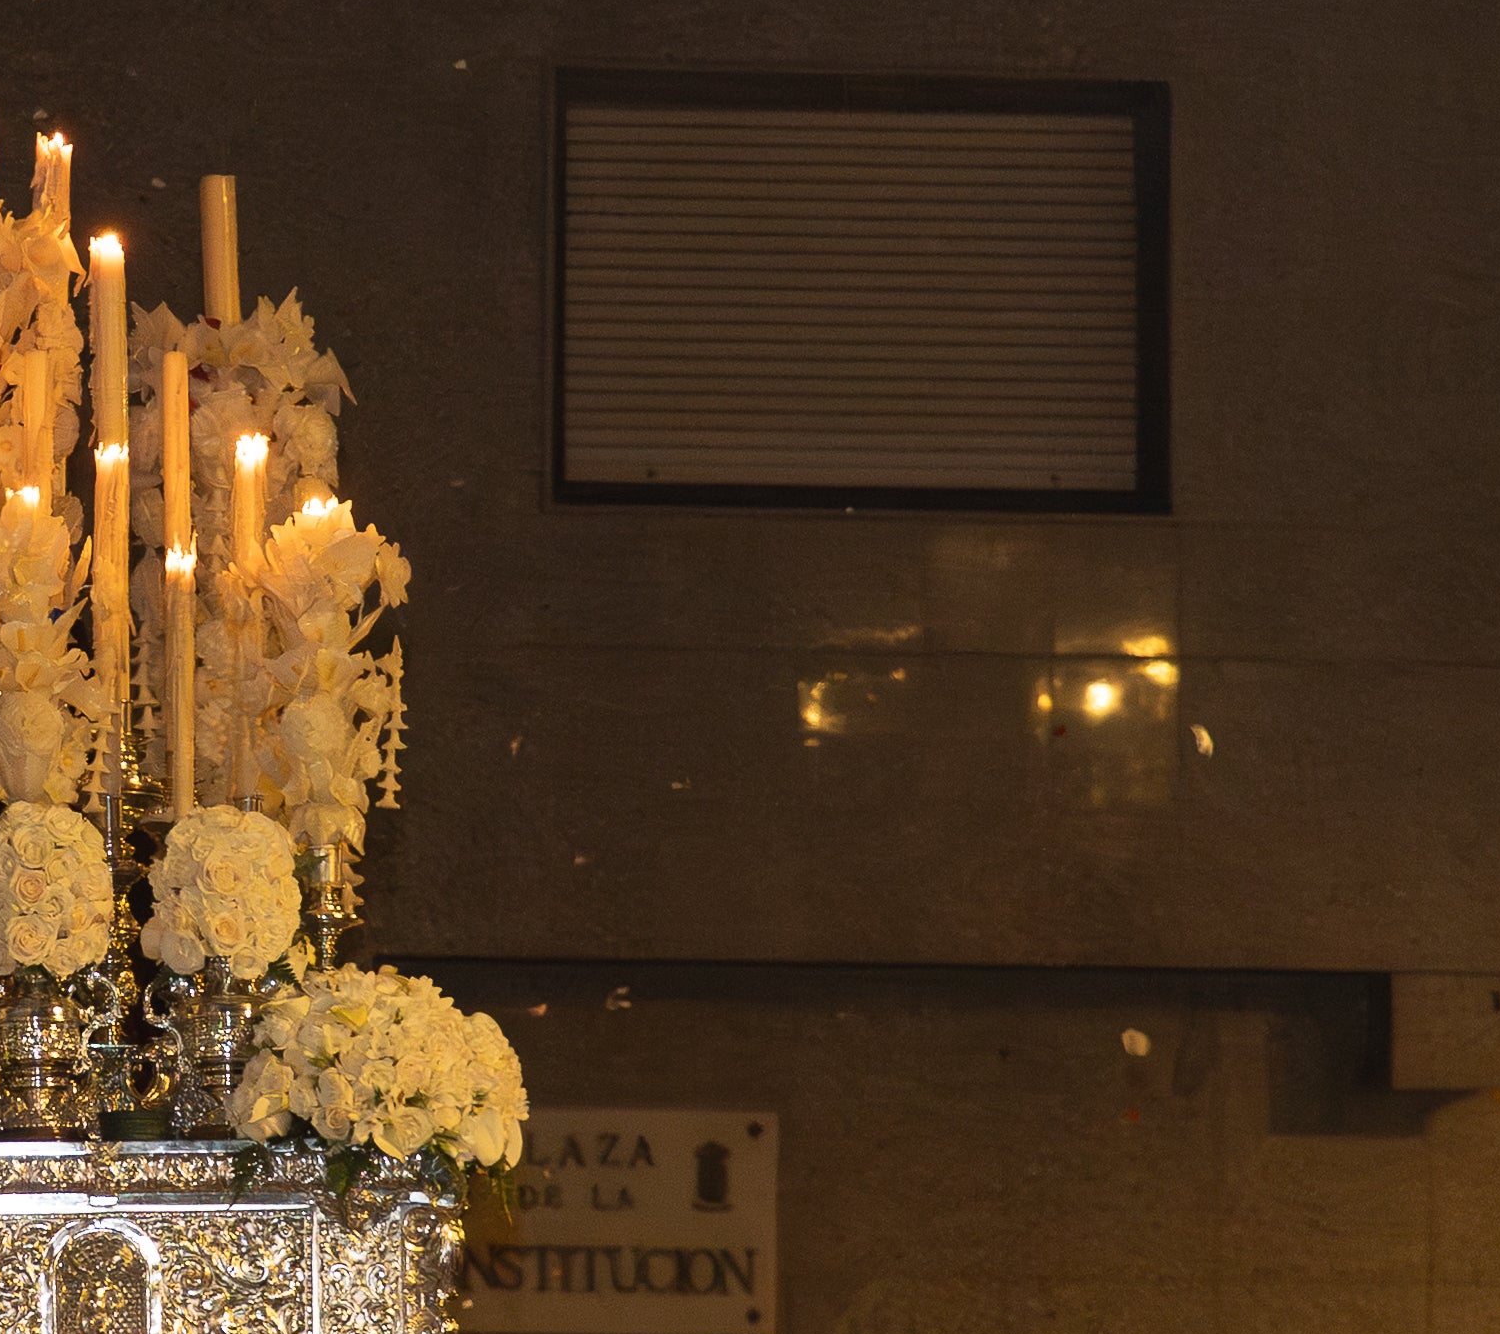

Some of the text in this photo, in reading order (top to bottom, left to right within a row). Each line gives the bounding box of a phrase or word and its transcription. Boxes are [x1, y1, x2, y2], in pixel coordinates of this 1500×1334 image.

[523, 1133, 655, 1167] LAZA
[518, 1184, 634, 1211] DE LA
[460, 1244, 757, 1296] NSTITUCION
